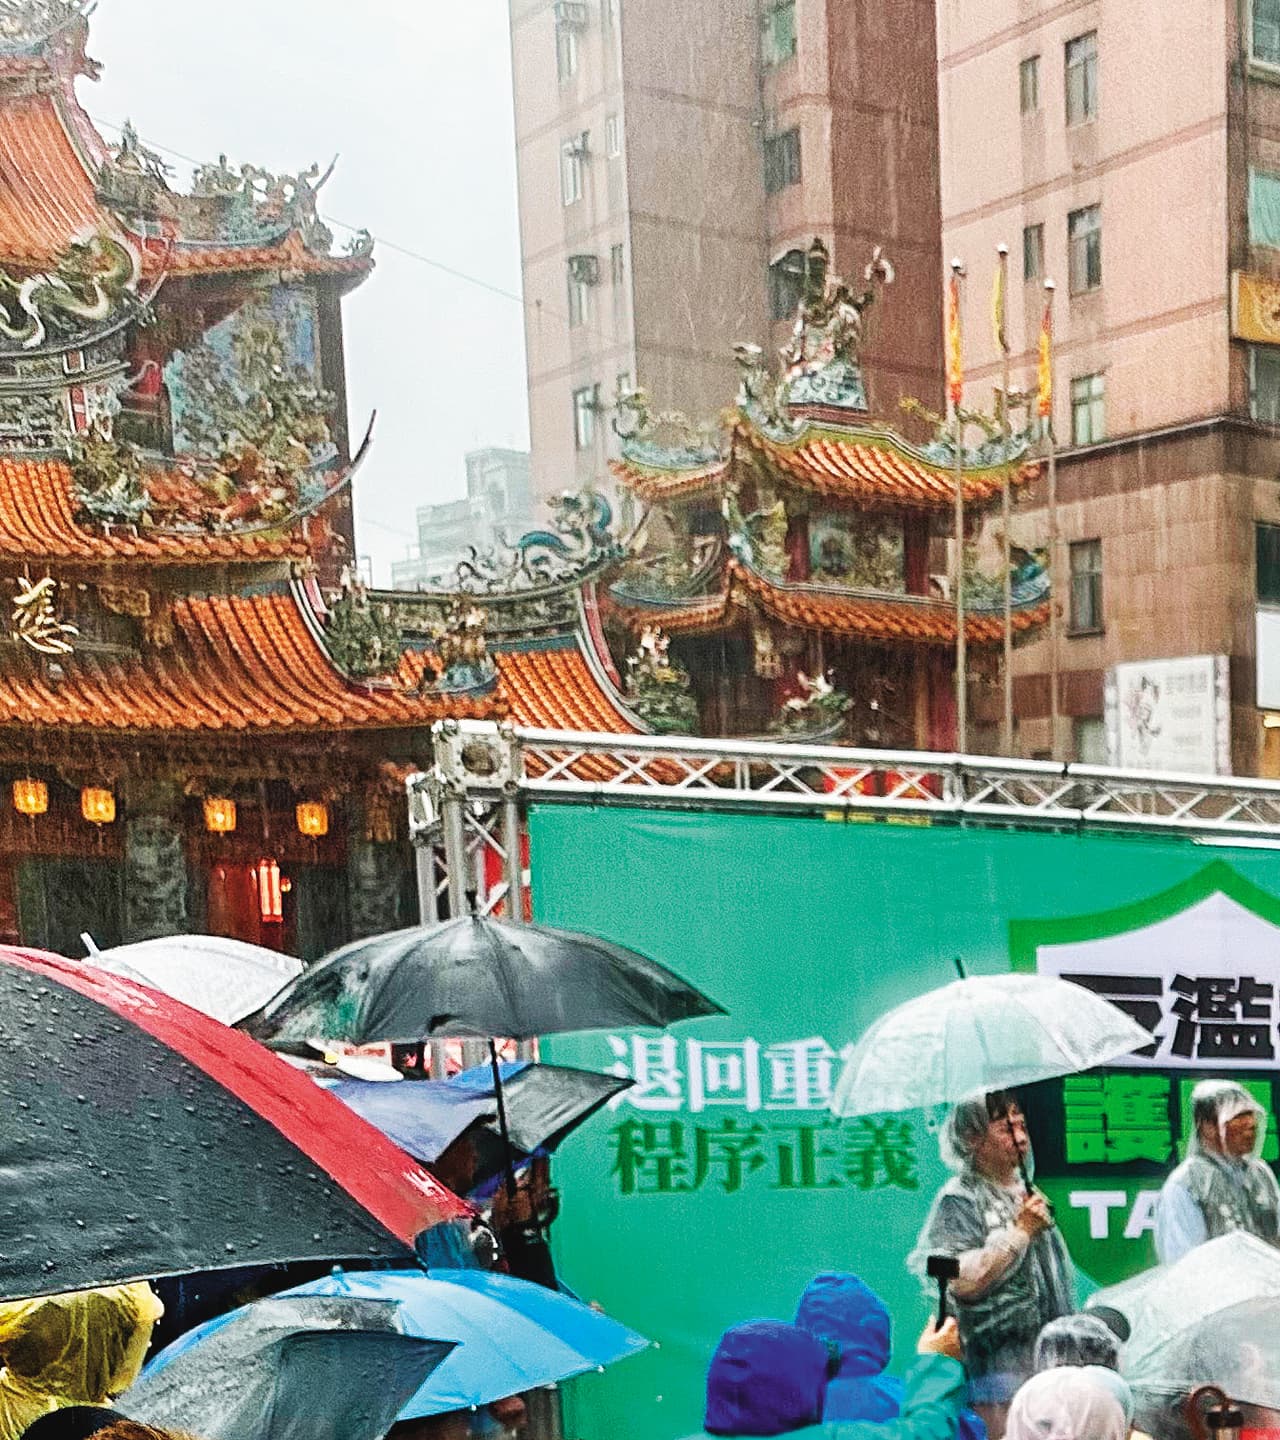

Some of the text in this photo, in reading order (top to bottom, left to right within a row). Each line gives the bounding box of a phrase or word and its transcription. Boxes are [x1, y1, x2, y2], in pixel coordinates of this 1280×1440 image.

[603, 1034, 855, 1112] 退回重
[607, 1117, 919, 1195] 程序正義
